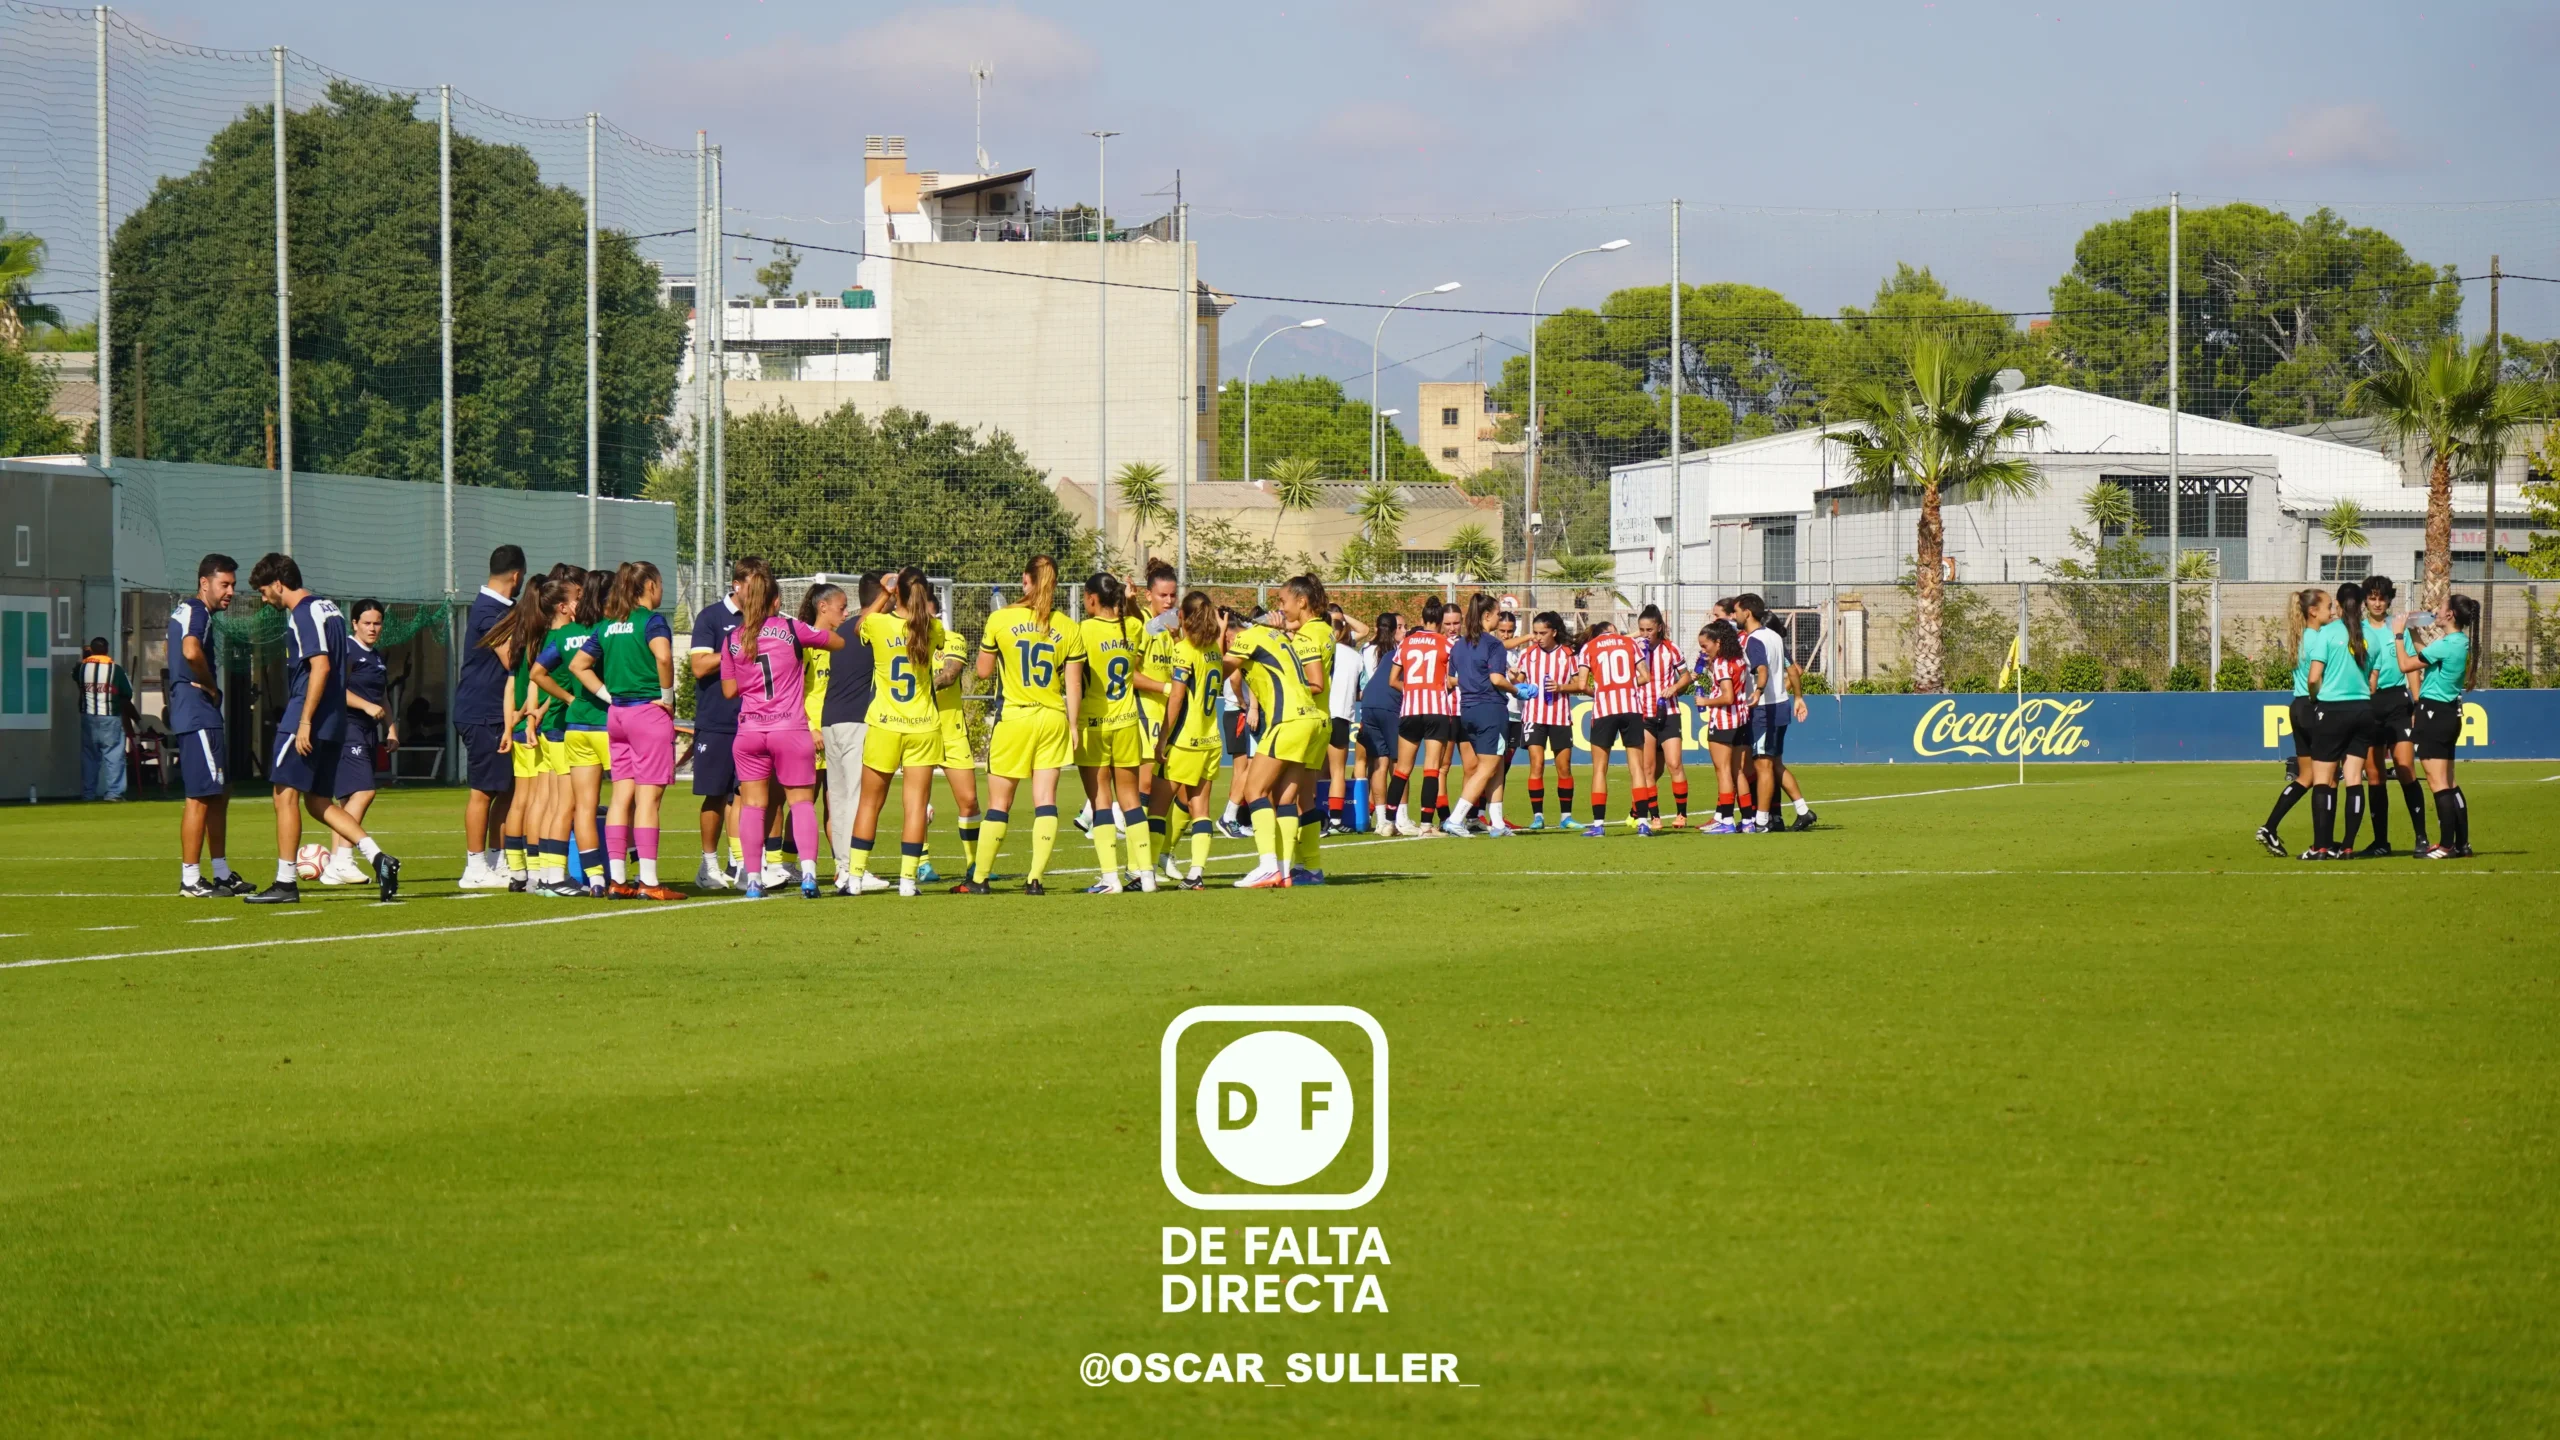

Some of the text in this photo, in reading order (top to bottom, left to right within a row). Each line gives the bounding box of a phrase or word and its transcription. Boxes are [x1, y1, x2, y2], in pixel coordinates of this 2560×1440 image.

[754, 652, 775, 701] 1
[891, 655, 917, 703] 5
[1015, 639, 1055, 688] 15
[1106, 655, 1130, 701] 8
[1406, 648, 1438, 685] 21
[1596, 648, 1630, 687] 10
[1203, 668, 1221, 717] 6
